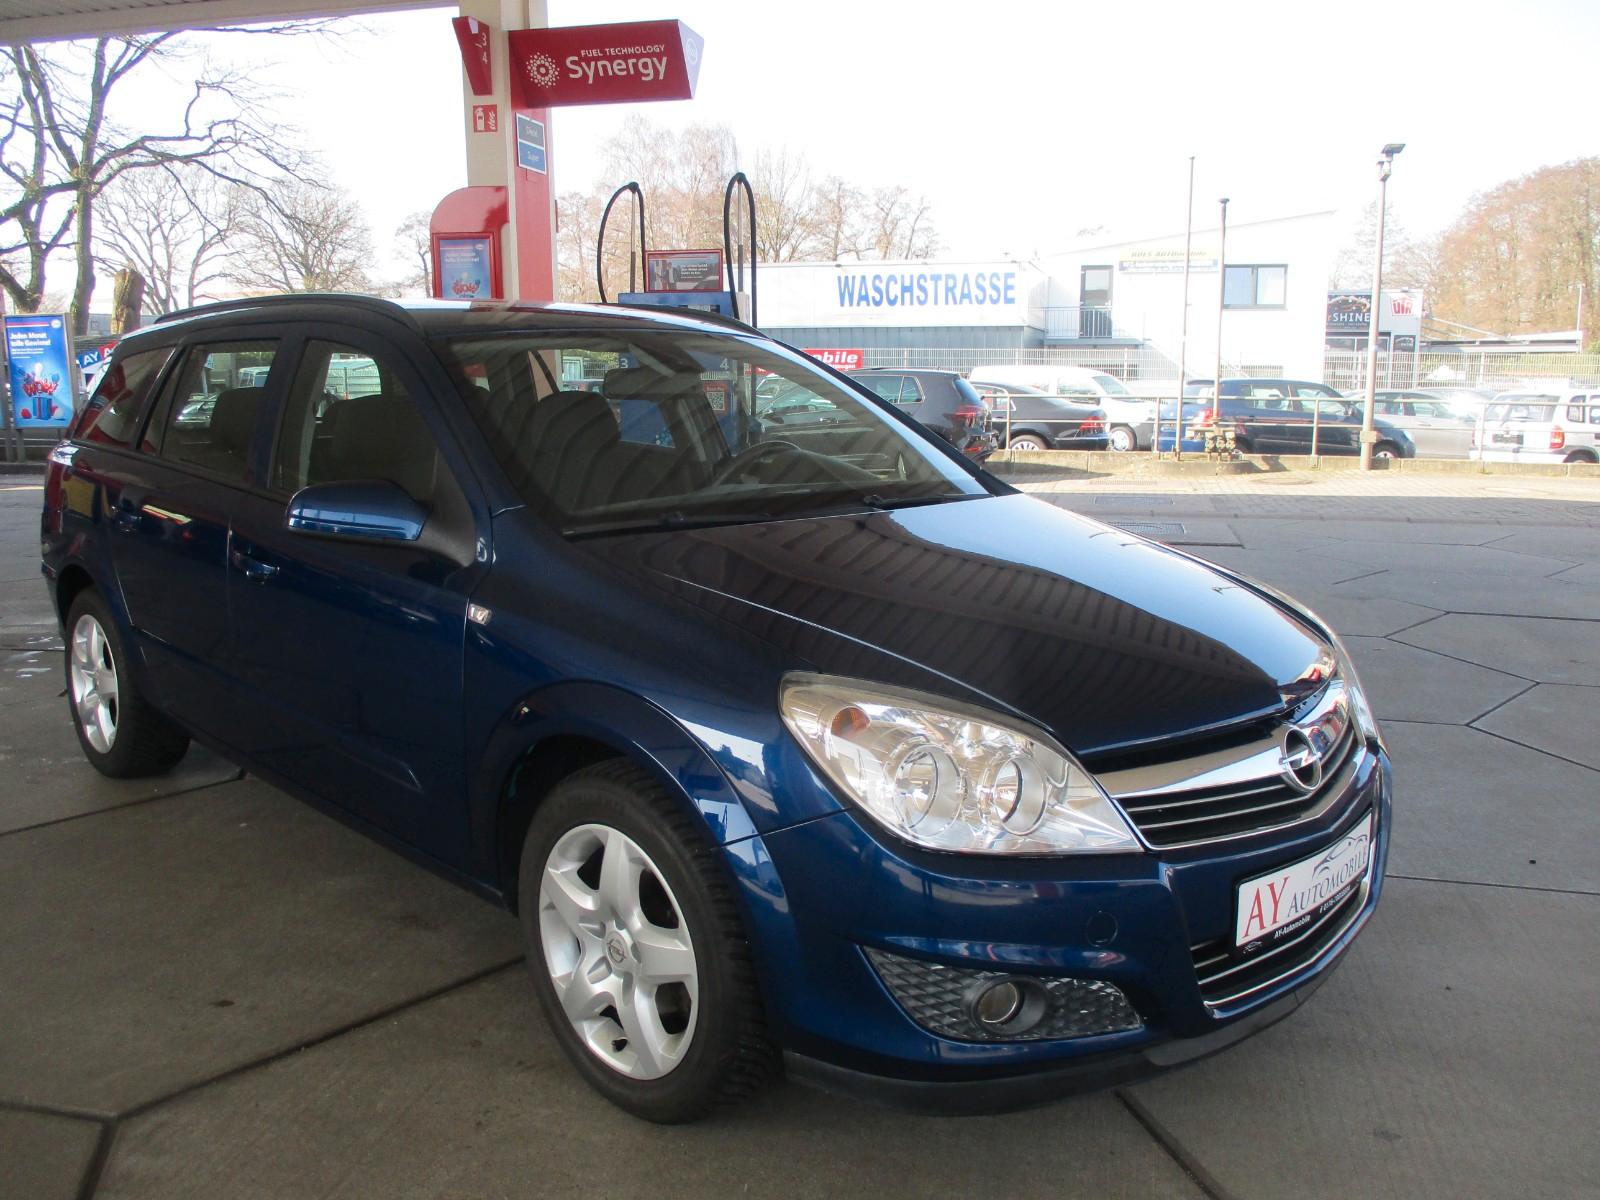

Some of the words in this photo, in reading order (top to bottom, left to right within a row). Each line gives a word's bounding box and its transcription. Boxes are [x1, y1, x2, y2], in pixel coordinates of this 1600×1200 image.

[580, 49, 601, 58] FUEL
[604, 44, 666, 56] TECHNOLOGY
[565, 56, 667, 84] Synergy
[837, 271, 1017, 308] WASCHSTRASSE
[1332, 312, 1371, 322] SHINE
[83, 351, 99, 366] AY
[620, 358, 629, 369] 3
[719, 357, 730, 370] 4
[1241, 875, 1291, 939] AY
[1287, 846, 1367, 917] AUTOMOBILE
